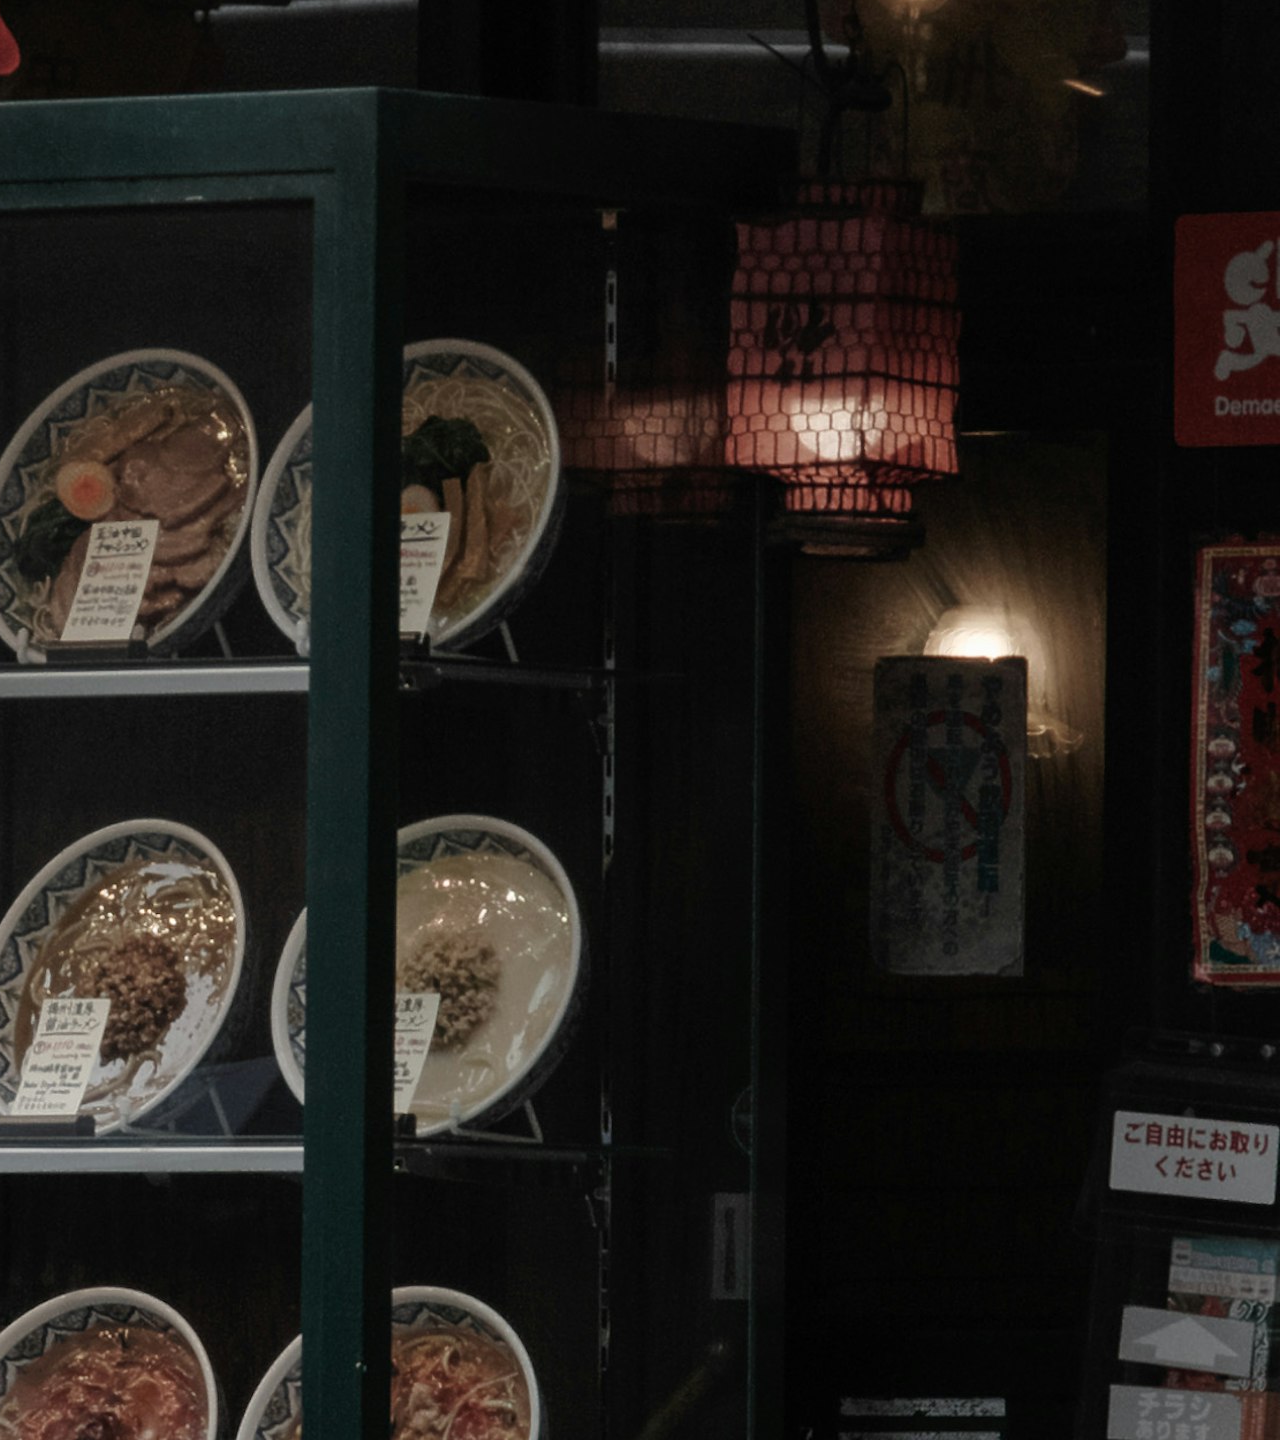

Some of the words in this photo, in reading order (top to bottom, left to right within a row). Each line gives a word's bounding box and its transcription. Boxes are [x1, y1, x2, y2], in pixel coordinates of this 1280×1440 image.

[1125, 1122, 1269, 1155] ご自由にお取り
[1155, 1156, 1237, 1182] ください
